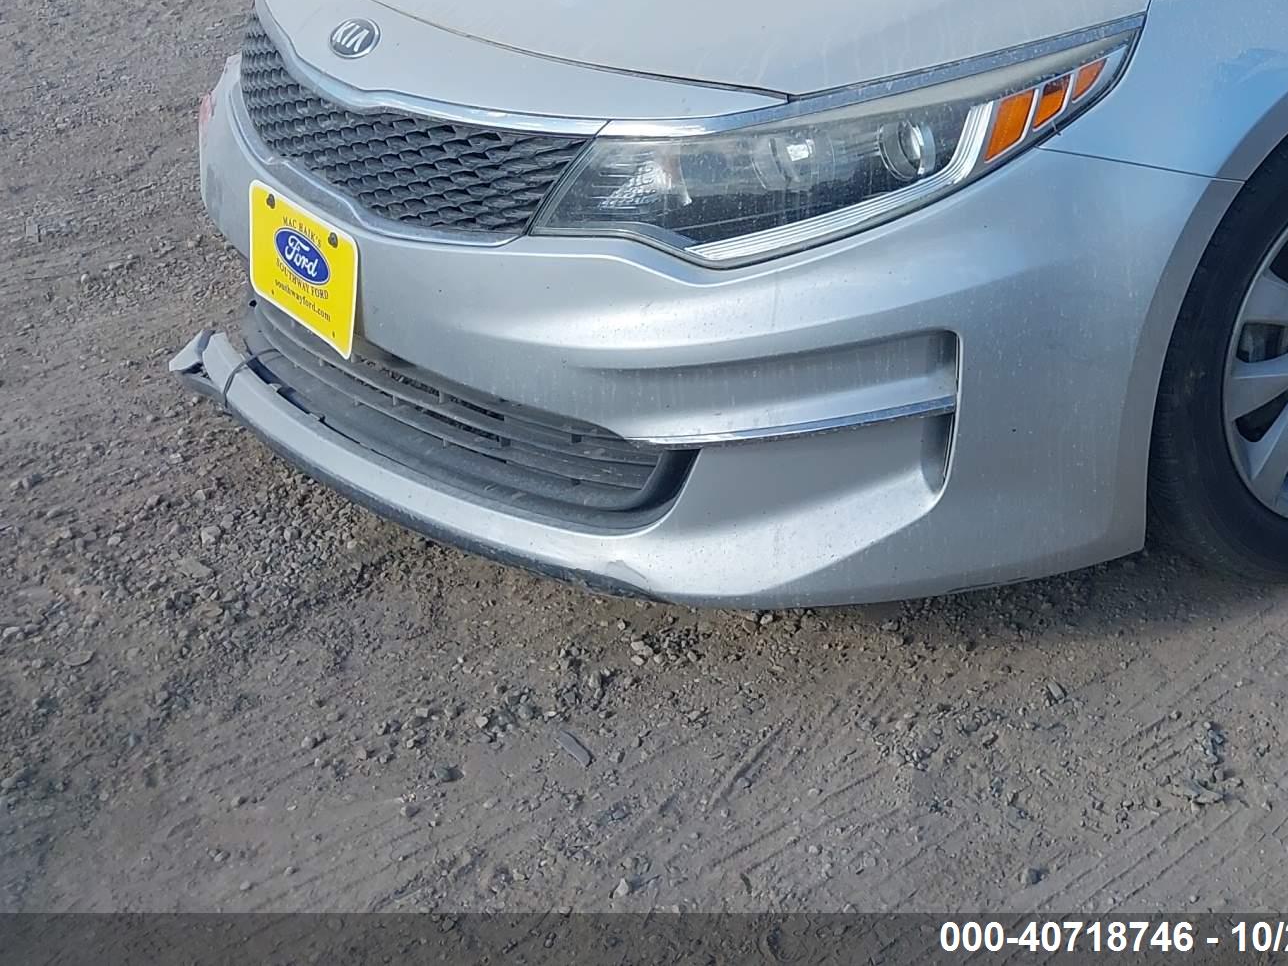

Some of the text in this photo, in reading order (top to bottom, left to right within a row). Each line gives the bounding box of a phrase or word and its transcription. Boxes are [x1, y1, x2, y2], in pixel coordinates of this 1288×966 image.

[333, 21, 370, 52] KIA
[283, 215, 297, 229] MAC
[284, 235, 319, 278] Ford
[276, 257, 329, 300] SOUTHWAY FORD
[275, 278, 331, 323] southwayford.com
